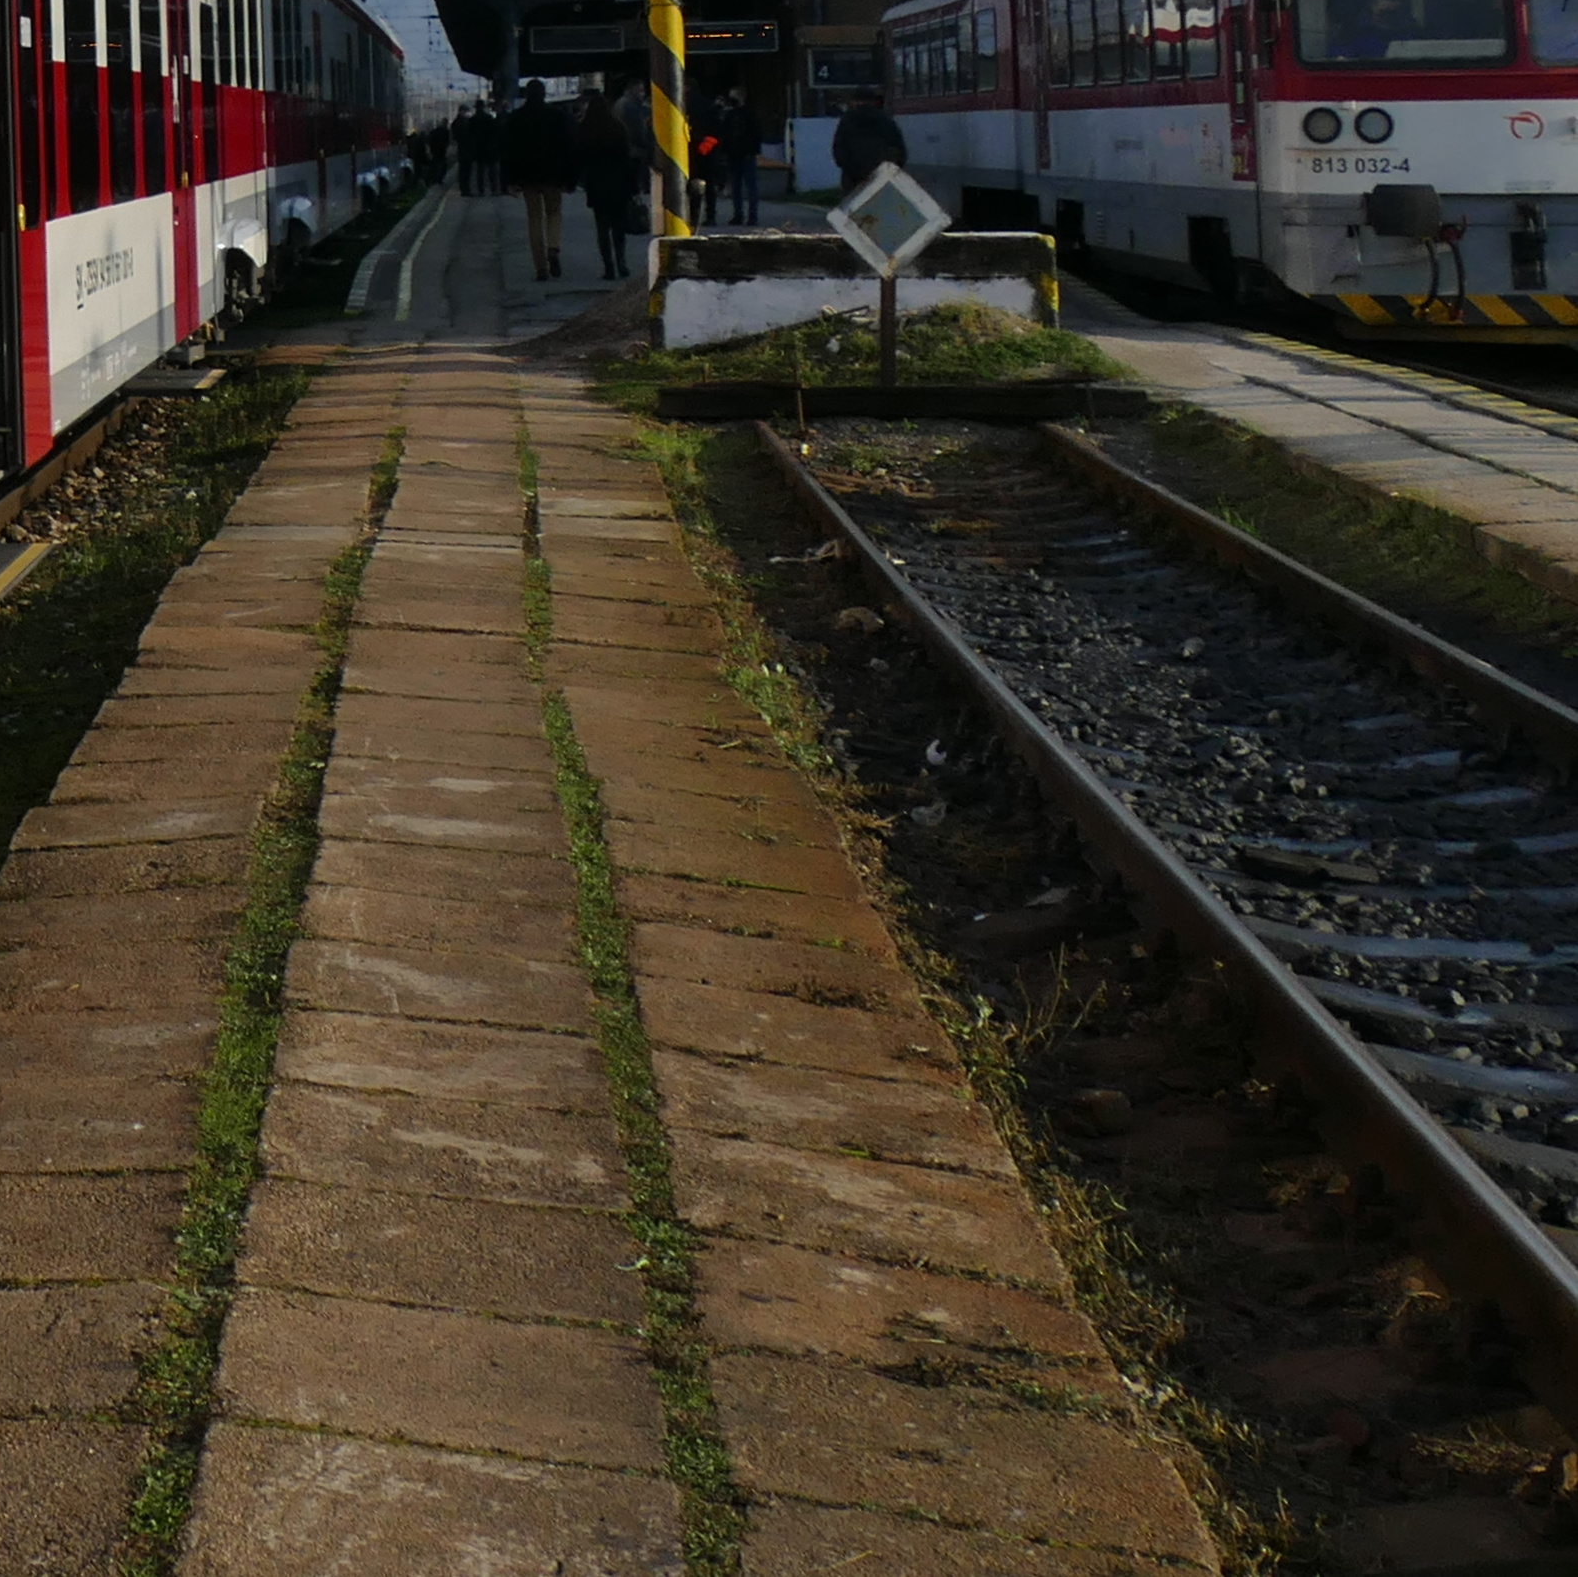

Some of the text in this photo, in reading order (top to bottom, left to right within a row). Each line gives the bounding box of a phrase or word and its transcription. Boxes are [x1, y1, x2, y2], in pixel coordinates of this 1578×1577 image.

[817, 65, 830, 79] 4
[1312, 157, 1411, 173] 813 032-4
